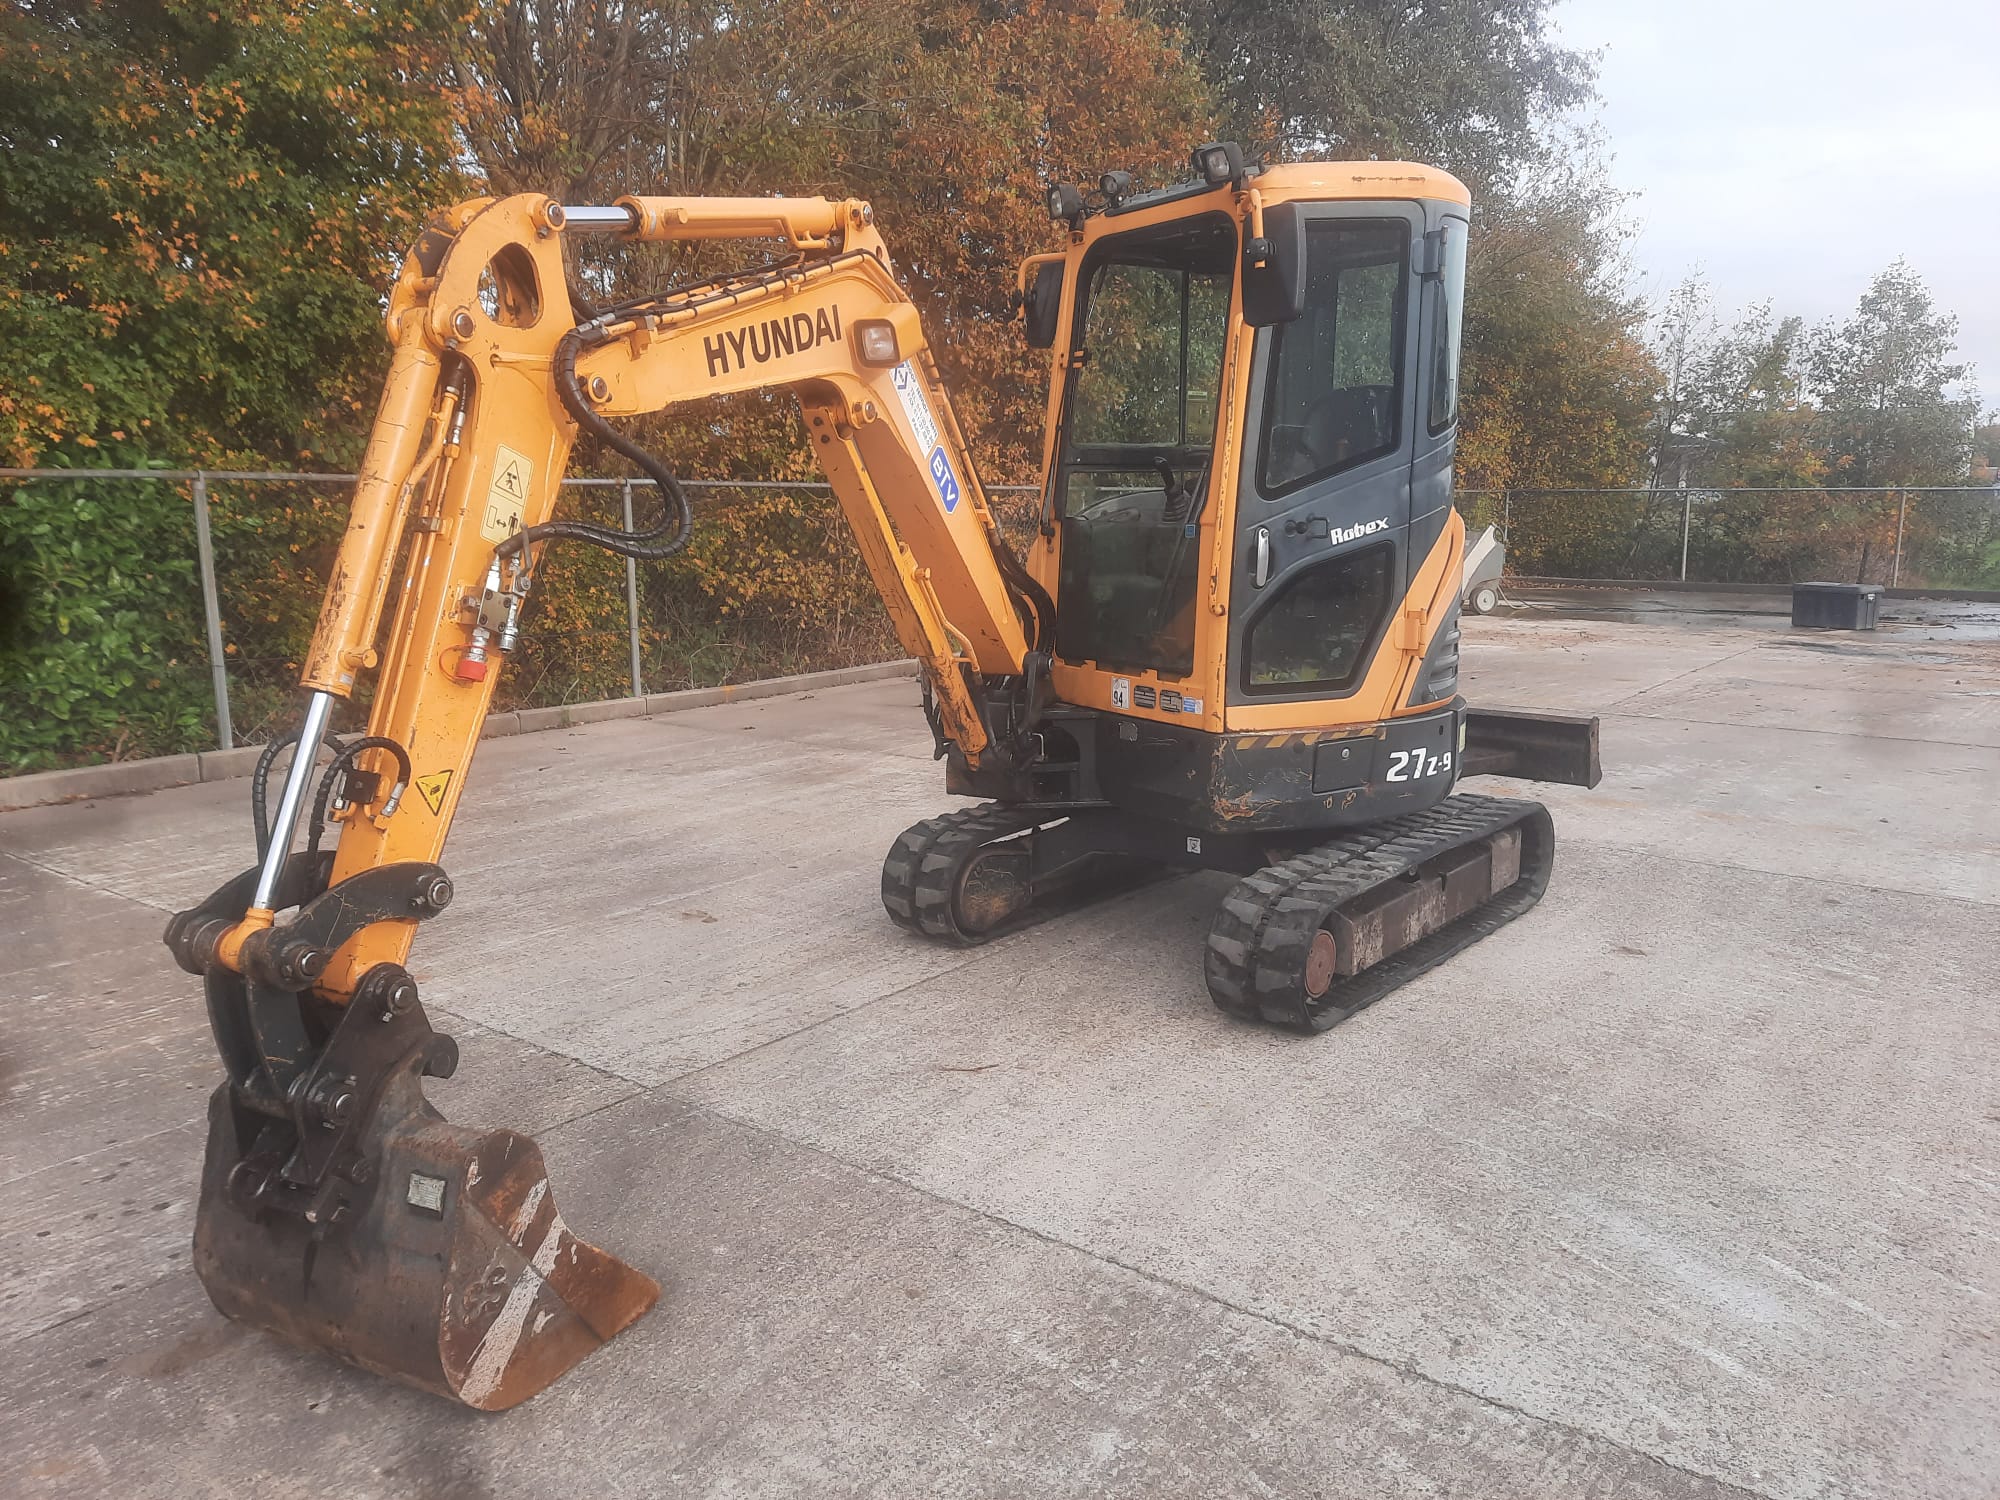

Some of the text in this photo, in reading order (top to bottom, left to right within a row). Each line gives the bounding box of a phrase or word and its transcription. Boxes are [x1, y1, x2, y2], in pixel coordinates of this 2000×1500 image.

[703, 304, 842, 377] HYUNDAI
[933, 455, 956, 501] BTV
[1330, 517, 1389, 545] Robex
[1113, 690, 1123, 708] 94
